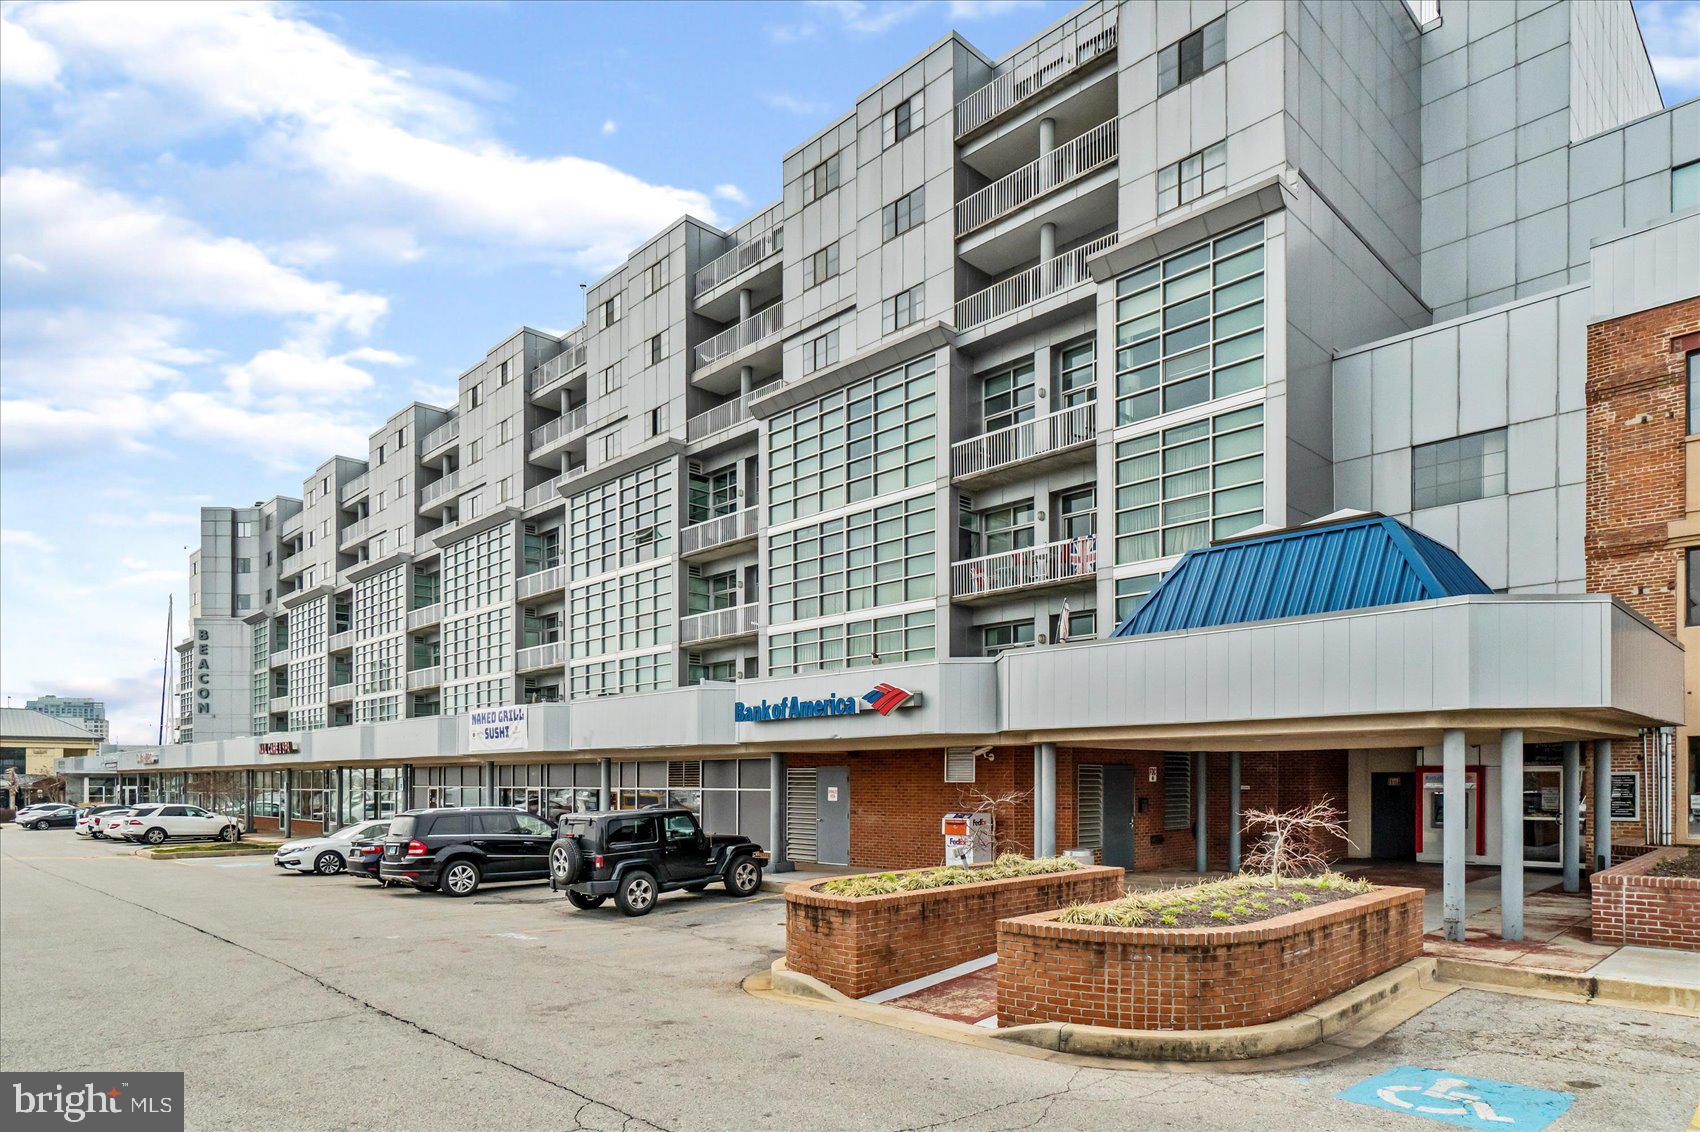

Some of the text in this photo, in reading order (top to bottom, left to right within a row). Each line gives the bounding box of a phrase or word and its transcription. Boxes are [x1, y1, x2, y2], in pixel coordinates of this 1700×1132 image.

[197, 629, 210, 714] BEACON
[472, 708, 524, 725] NAKED GRILL
[735, 693, 855, 722] Bank of America
[485, 726, 509, 739] SUSHI
